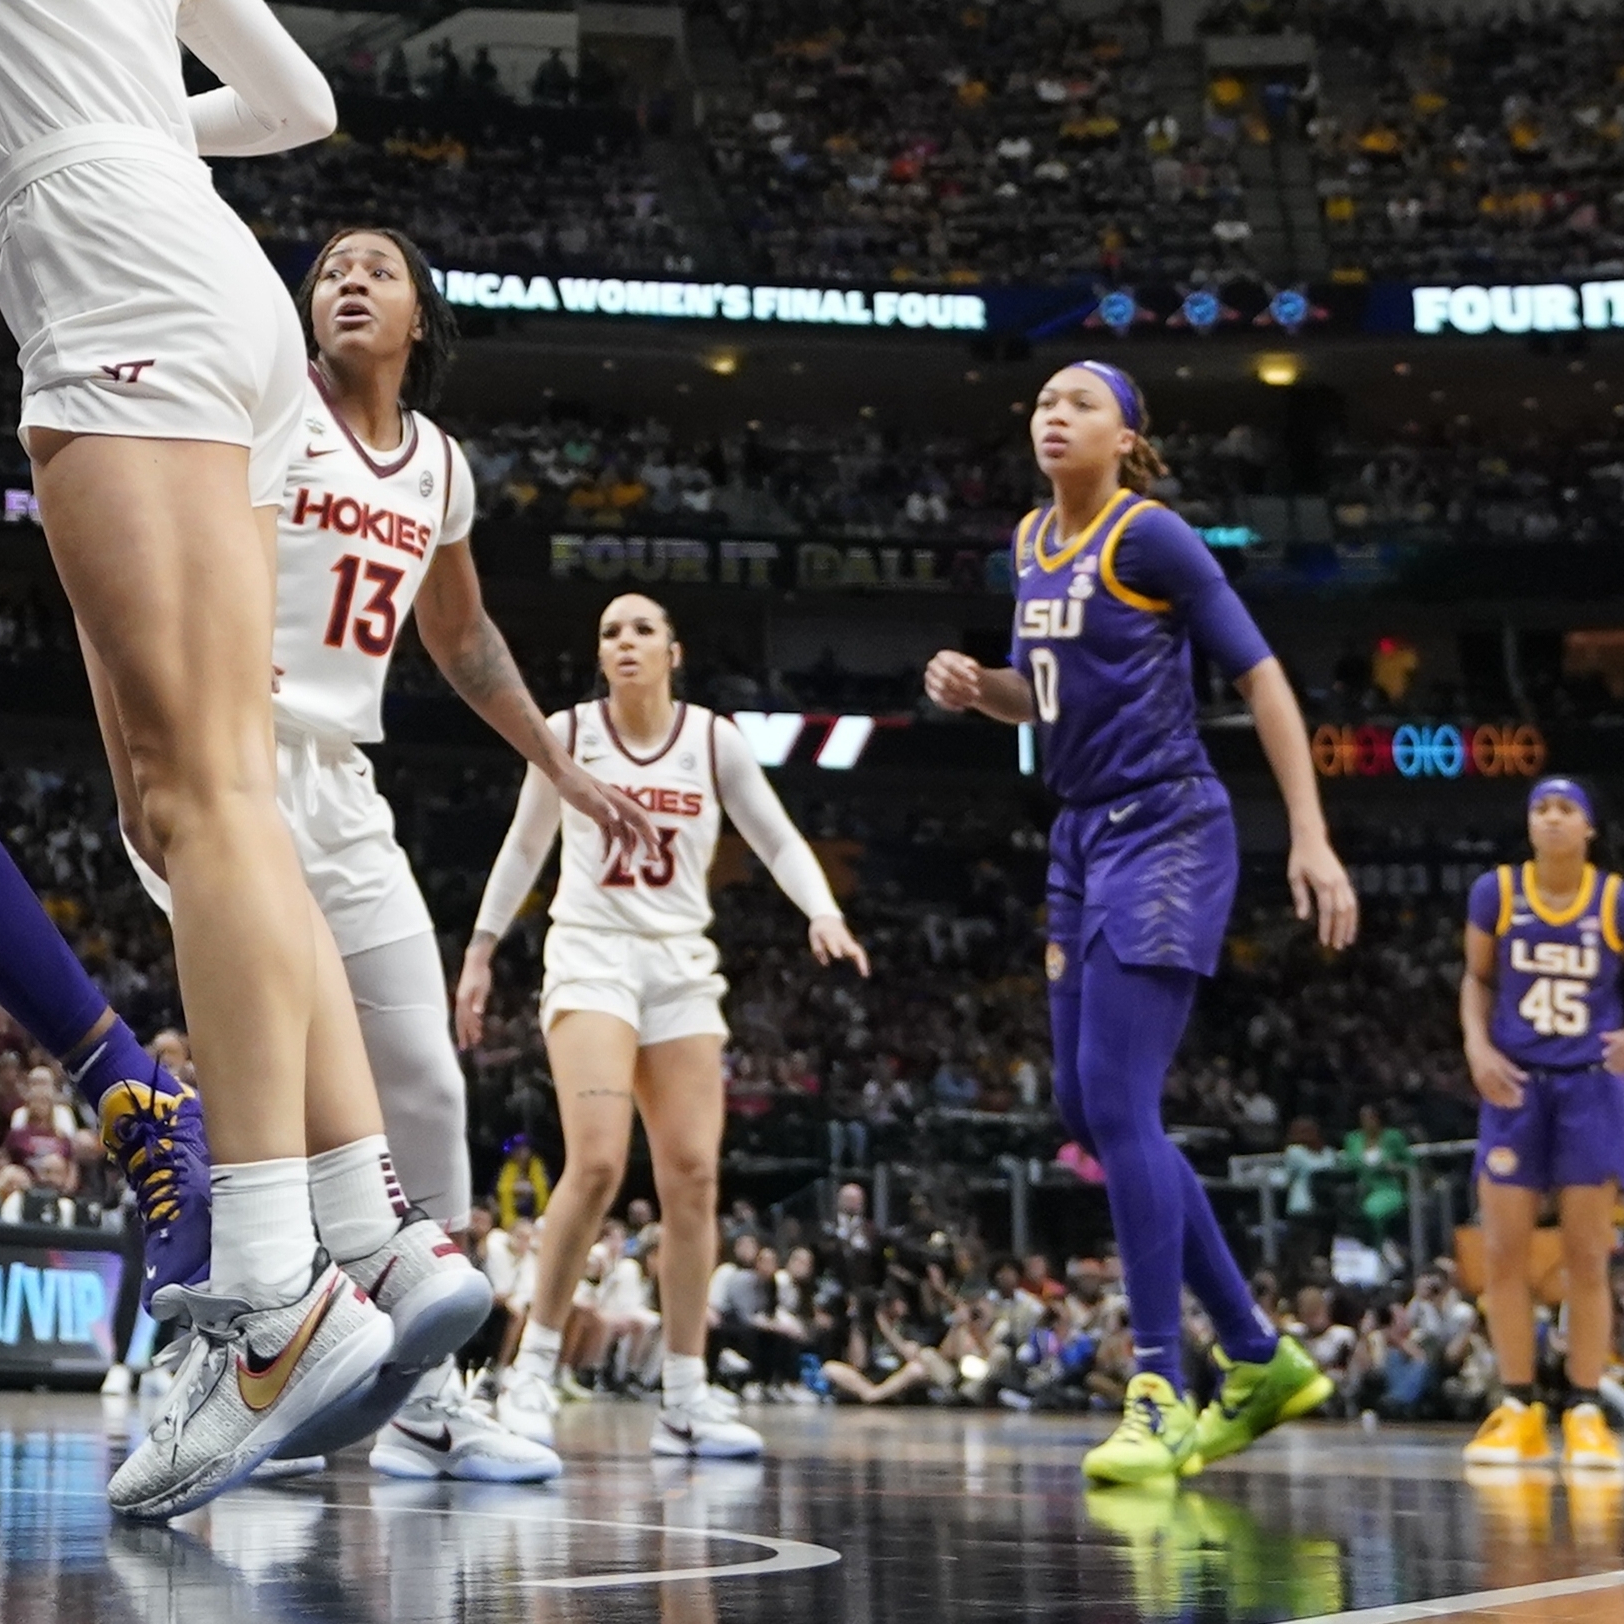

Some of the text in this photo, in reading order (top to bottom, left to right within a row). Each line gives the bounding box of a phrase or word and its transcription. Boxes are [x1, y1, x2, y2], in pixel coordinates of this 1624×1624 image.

[446, 270, 558, 311] NCAA
[558, 277, 751, 321] WOMEN'S
[752, 286, 873, 325] FINAL
[873, 291, 987, 331] FOUR
[1413, 285, 1579, 334] FOUR
[291, 486, 432, 562] HOKIES
[323, 553, 408, 658] 13
[1028, 646, 1060, 724] 0
[1510, 937, 1601, 978] LSU
[1518, 977, 1591, 1038] 45
